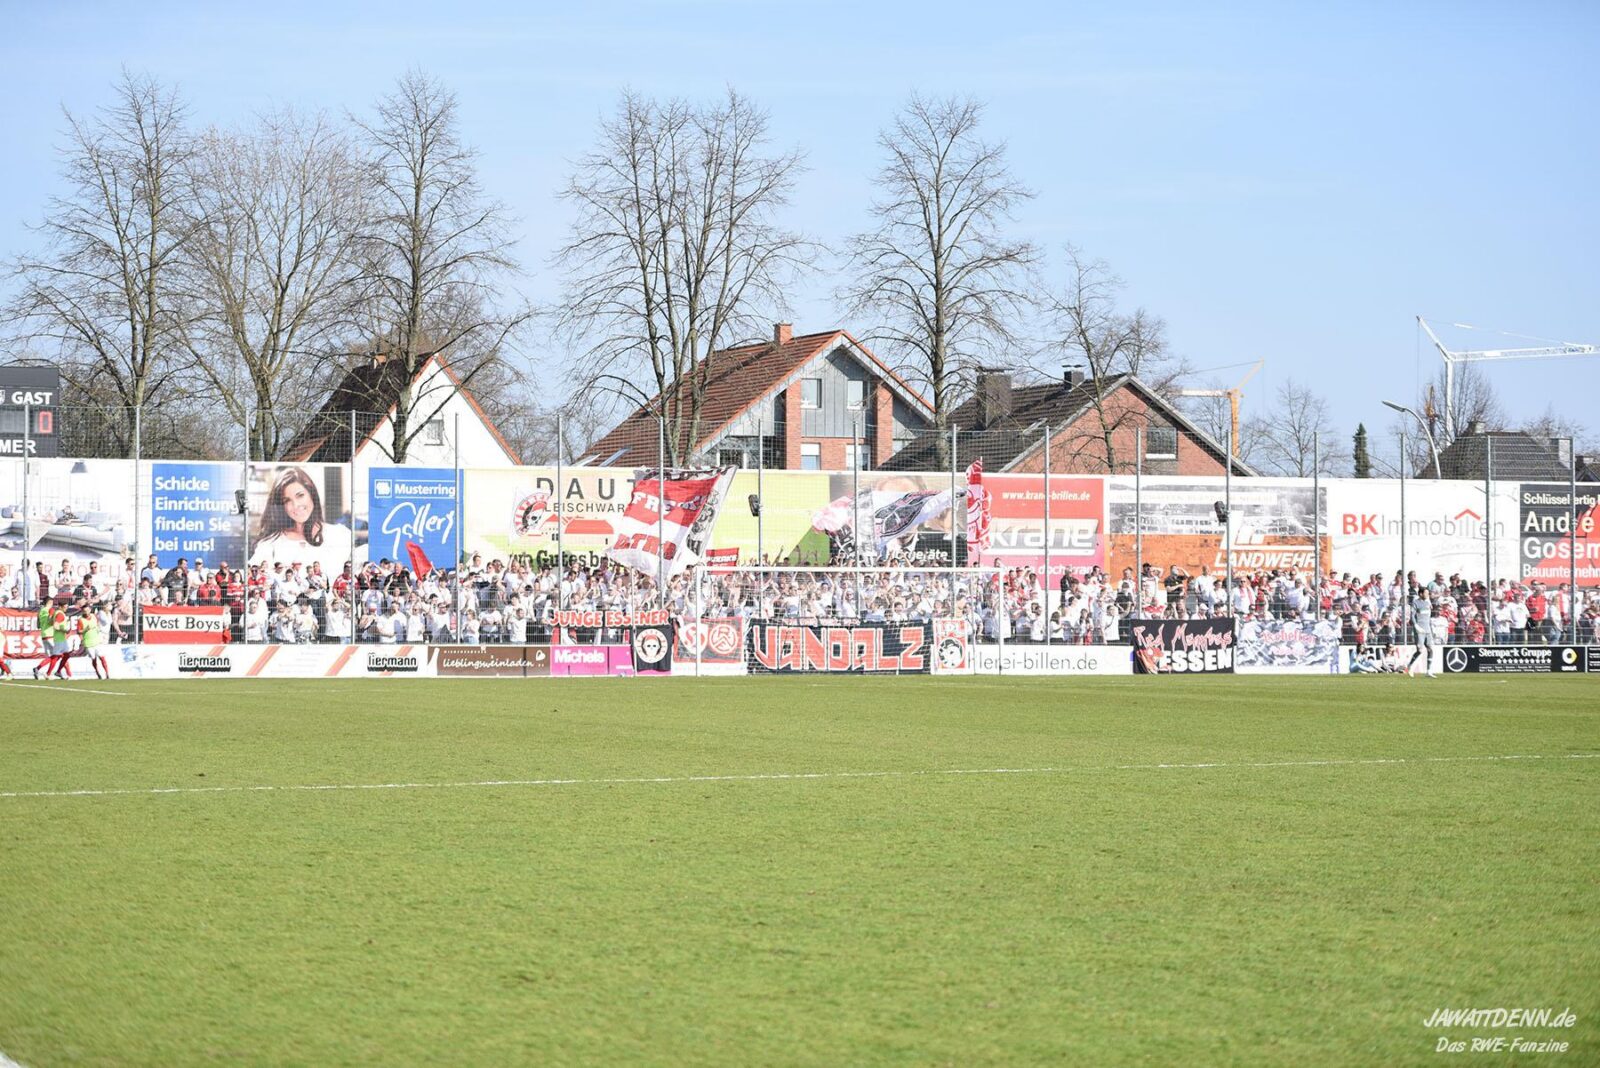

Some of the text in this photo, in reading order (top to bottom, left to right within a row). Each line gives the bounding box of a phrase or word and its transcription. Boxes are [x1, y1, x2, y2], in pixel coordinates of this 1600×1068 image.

[12, 391, 53, 405] GAST
[155, 476, 210, 491] Schicke
[395, 484, 456, 497] Musterring
[1002, 490, 1091, 501] www.kran-brillen.de
[1523, 492, 1597, 508] Schlüsselertig
[540, 502, 625, 514] LEISCHWAR
[155, 516, 232, 531] finden Sie
[1523, 510, 1595, 533] Andé
[382, 501, 456, 560] Gallery
[155, 537, 215, 551] bei uns!
[537, 549, 587, 568] Gutes
[1522, 563, 1600, 579] Bauunteneh
[145, 616, 221, 633] West Boys
[549, 609, 669, 628] JUNGE ESSENER
[753, 625, 925, 671] VANDALZ
[1521, 647, 1552, 660] Gruppe
[554, 649, 606, 663] Michels
[1159, 647, 1233, 672] ESSEN
